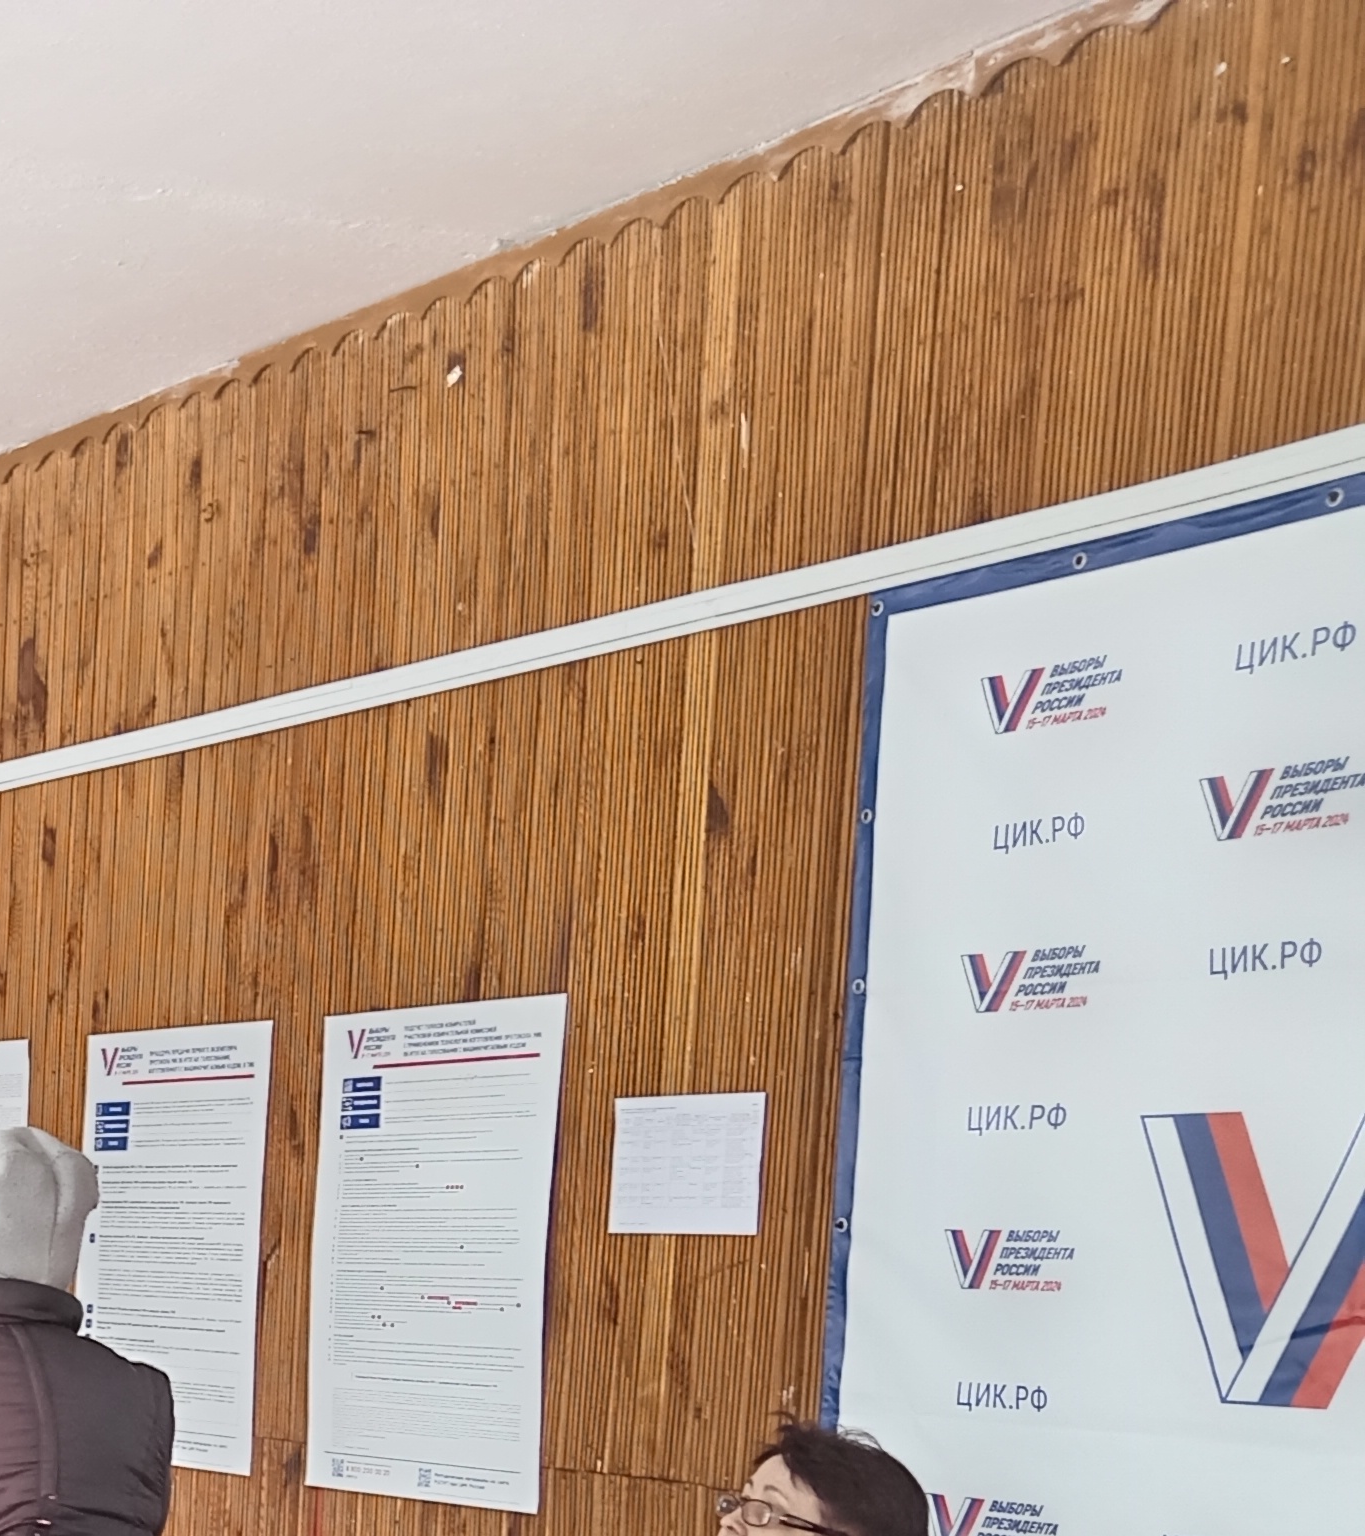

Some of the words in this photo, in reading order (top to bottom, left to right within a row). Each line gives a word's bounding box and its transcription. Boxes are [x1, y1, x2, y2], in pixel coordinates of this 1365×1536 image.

[1234, 620, 1357, 675] ЦИК.РФ
[1049, 654, 1107, 678] ВЫБОРЫ
[1041, 669, 1123, 696] ПРЕЗИДЕНТА
[1031, 693, 1086, 714] РОССИИ
[1279, 756, 1350, 781] ВЫБОРЫ
[1260, 797, 1324, 820] РОССИИ
[992, 812, 1087, 855] ЦИК.РФ
[1031, 945, 1086, 962] ВЫБОРЫ
[1208, 937, 1323, 981] ЦИК.РФ
[1023, 960, 1101, 979] ПРЕЗИДЕНТА
[1014, 981, 1067, 997] РОССИИ
[966, 1102, 1068, 1137] ЦИК.РФ
[1005, 1230, 1060, 1243] ВЫБОРЫ
[999, 1247, 1075, 1261] ПРЕЗИДЕНТА
[993, 1263, 1041, 1276] РОССИИ
[955, 1381, 1049, 1412] ЦИК.РФ
[989, 1500, 1044, 1517] ВЫБОРЫ
[982, 1516, 1059, 1536] ПРЕЗИДЕНТА
